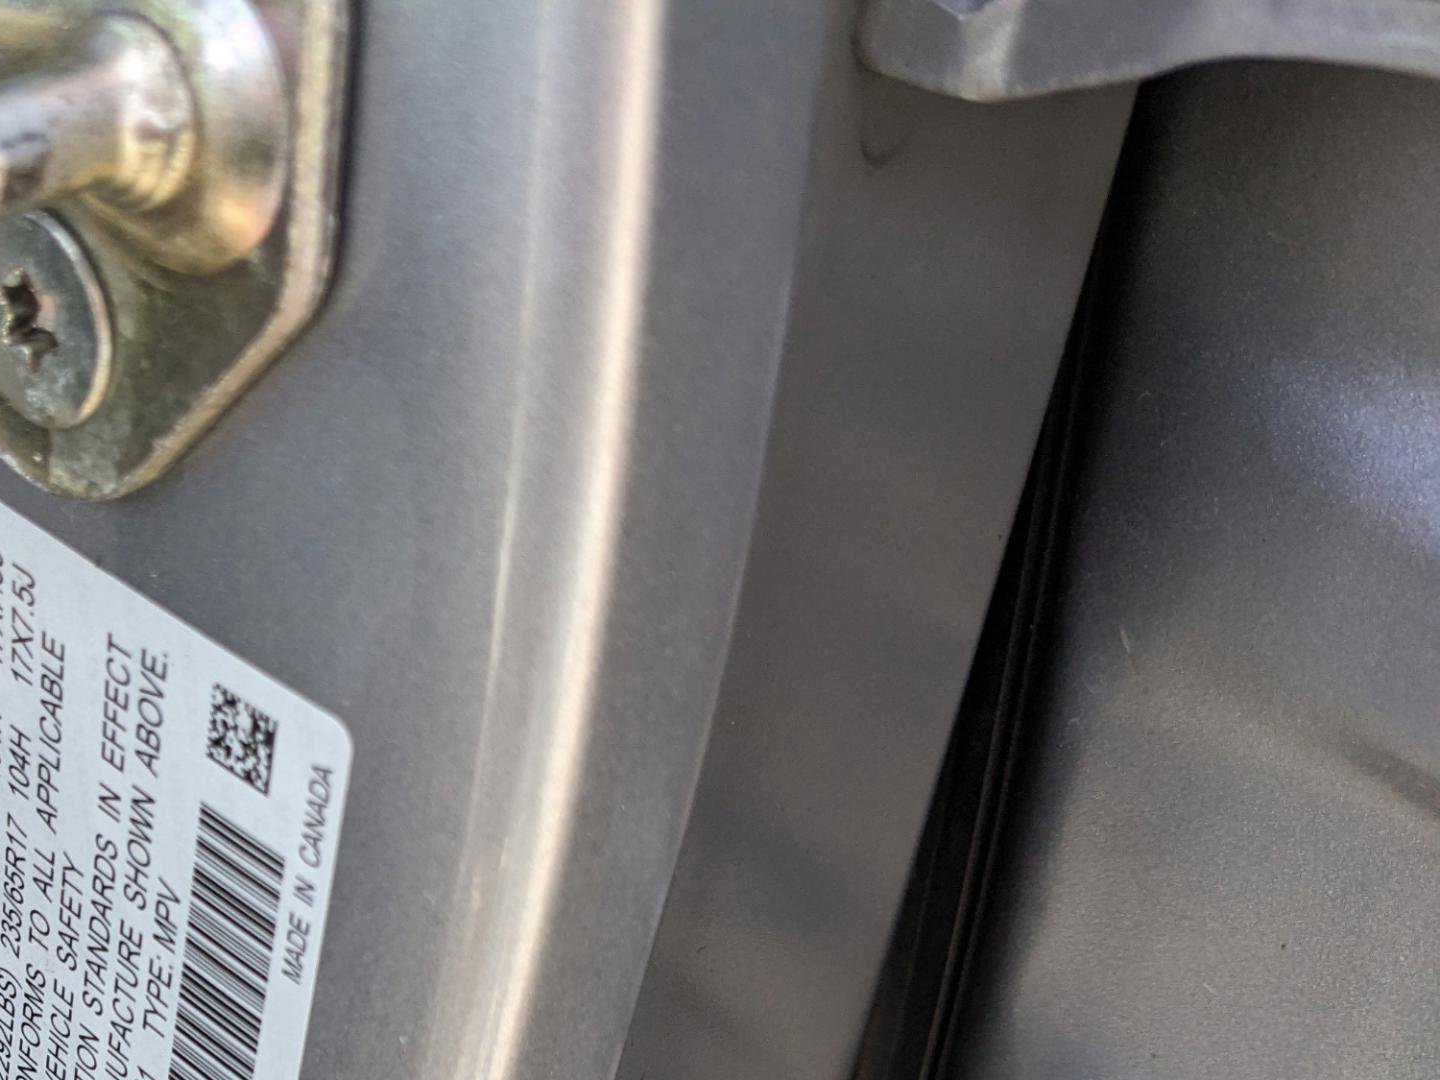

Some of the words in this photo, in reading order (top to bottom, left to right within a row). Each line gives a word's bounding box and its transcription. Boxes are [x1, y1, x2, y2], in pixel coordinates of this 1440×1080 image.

[10, 562, 36, 687] 17X7.5J
[35, 631, 65, 835] APPLICABLE
[100, 632, 132, 773] EFFECT
[134, 648, 168, 778] ABOVE.
[7, 724, 31, 800] 104H
[98, 782, 122, 823] IN
[123, 784, 156, 911] SHOWN
[298, 765, 334, 868] CANADA
[0, 812, 27, 960] 235/65R17
[32, 848, 56, 903] ALL
[56, 851, 84, 972] SAFETY
[81, 833, 118, 1017] STANDARDS
[152, 876, 181, 954] MPV
[294, 878, 315, 907] IN
[28, 909, 50, 951] TO
[281, 911, 311, 985] MADE
[142, 955, 173, 1039] TYPE:
